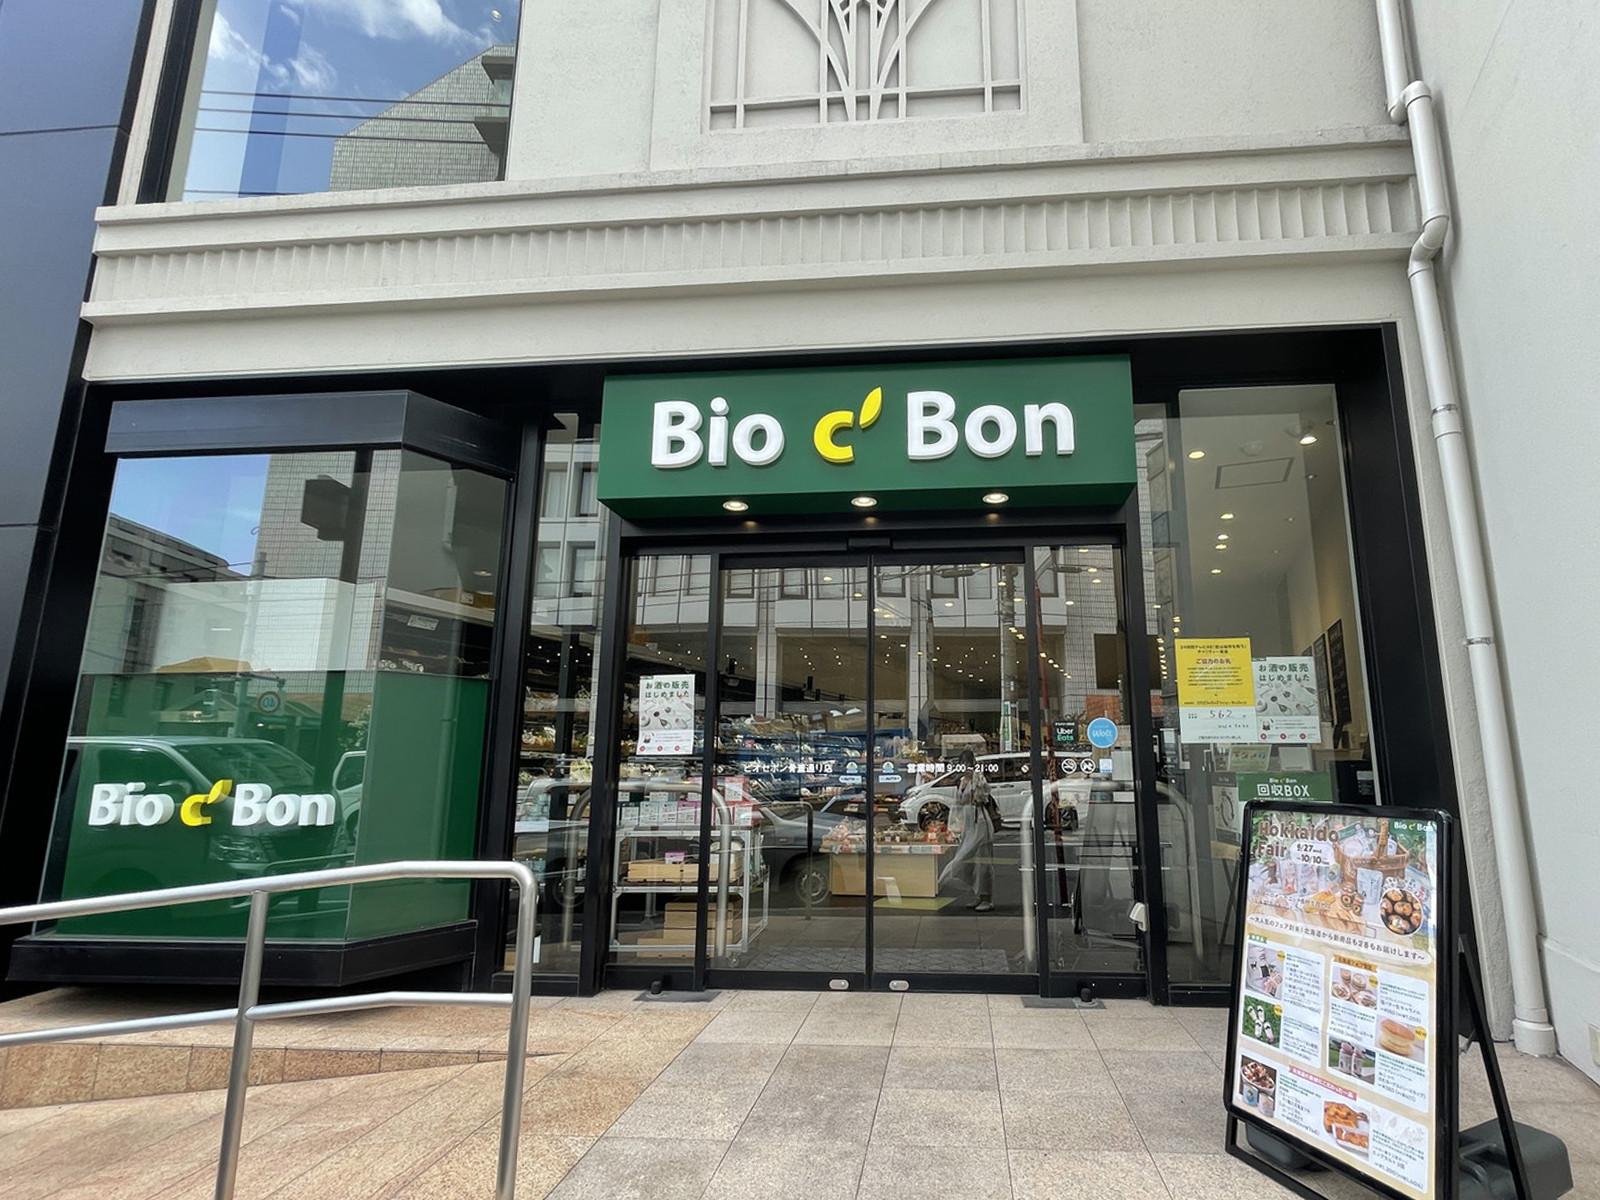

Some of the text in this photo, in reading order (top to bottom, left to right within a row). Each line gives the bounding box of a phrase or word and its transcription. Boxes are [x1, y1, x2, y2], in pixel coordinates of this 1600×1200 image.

[651, 397, 785, 469] Bio
[906, 390, 1075, 460] Bon
[1258, 663, 1309, 672] お酒の販売
[1258, 674, 1310, 682] はじめました
[645, 681, 689, 690] お酒の販売
[645, 690, 689, 699] はじめました
[1092, 729, 1112, 738] Wolt
[907, 763, 945, 773] 営業時間
[1257, 784, 1310, 797] 回収BOX
[88, 782, 175, 827] Bio
[231, 783, 337, 827] Bon
[1394, 821, 1408, 830] Bio
[1258, 821, 1339, 842] Hokkaido
[1257, 840, 1287, 858] Fair
